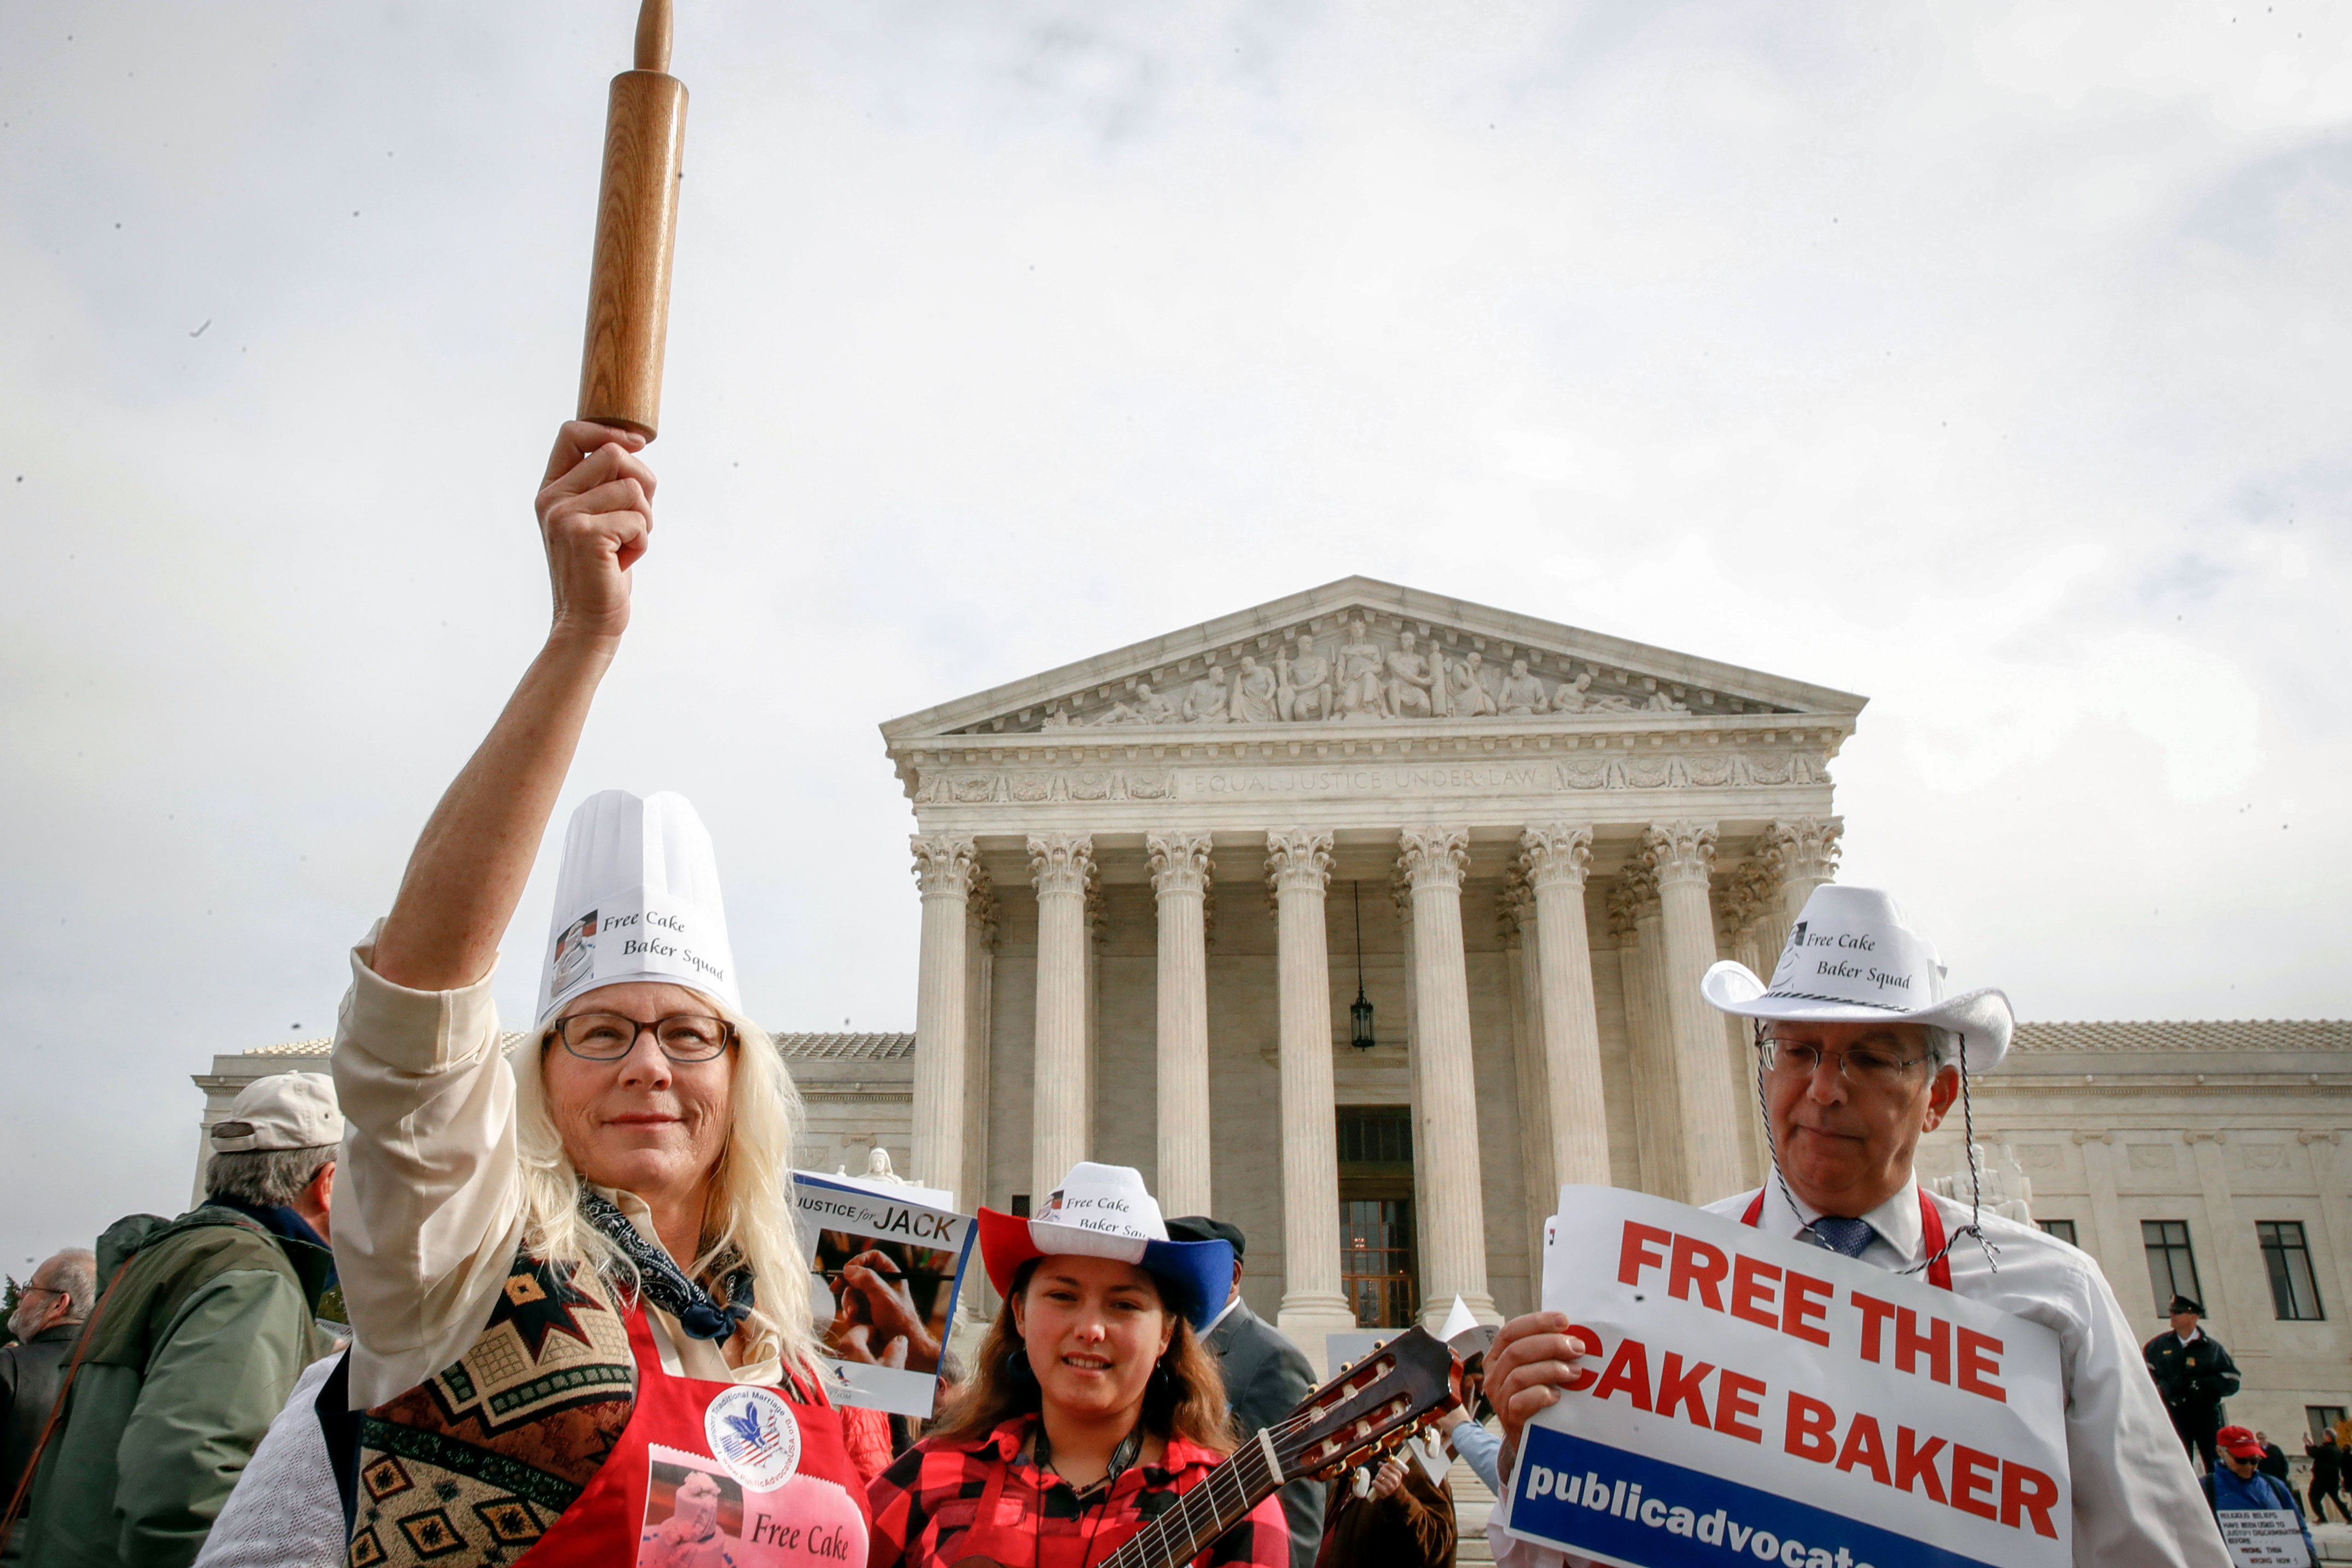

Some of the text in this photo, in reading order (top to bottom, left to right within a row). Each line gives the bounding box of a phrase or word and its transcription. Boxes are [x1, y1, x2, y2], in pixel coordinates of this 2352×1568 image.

[1195, 768, 1537, 793] EQUAL JUSTICE UNDER LAW
[602, 911, 685, 933] Free Cake
[1806, 933, 1875, 952] Free Cake
[623, 937, 724, 982] Baker Squad
[1817, 960, 1912, 989] Baker Squad
[797, 1197, 957, 1242] JUSTICE for JACK
[1066, 1197, 1130, 1213] Free Cake
[1080, 1218, 1120, 1232] Baker
[1617, 1220, 2007, 1404] FREE THE
[712, 1391, 749, 1414] Traditional
[752, 1391, 785, 1417] Marriage
[1784, 1390, 2059, 1541] BAKER
[1526, 1464, 1877, 1568] publicadvocat
[751, 1513, 848, 1560] Free Cake
